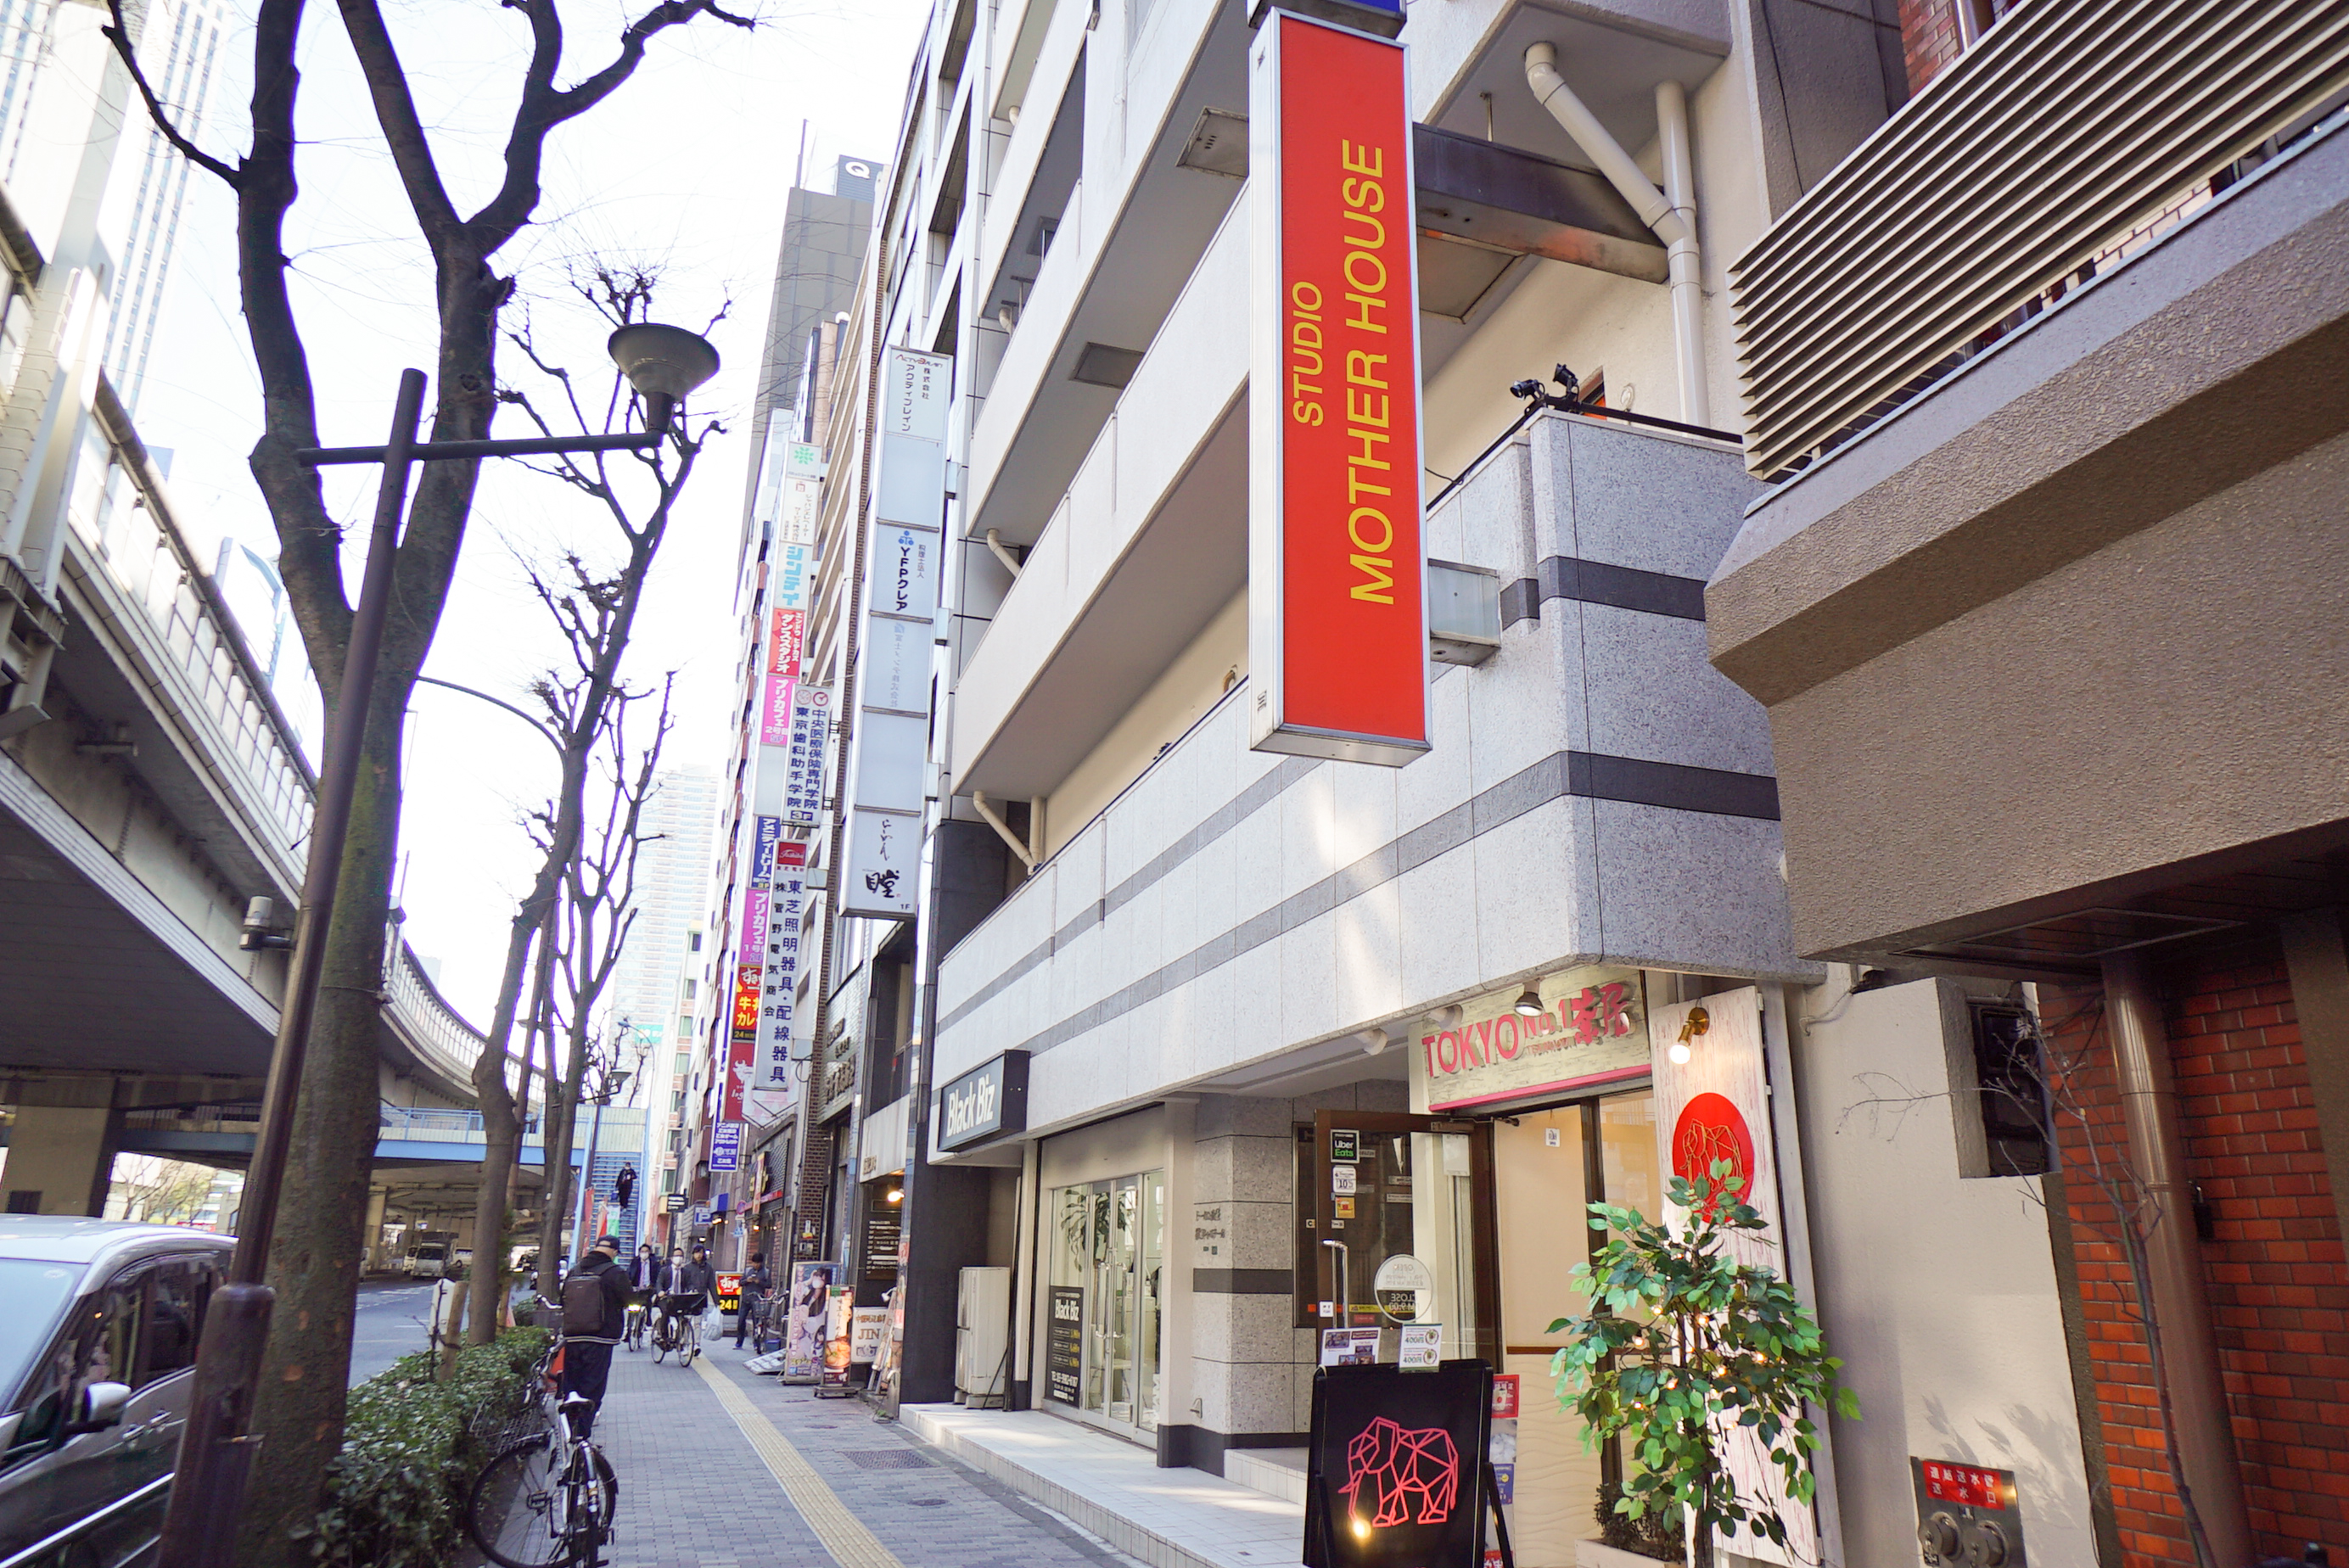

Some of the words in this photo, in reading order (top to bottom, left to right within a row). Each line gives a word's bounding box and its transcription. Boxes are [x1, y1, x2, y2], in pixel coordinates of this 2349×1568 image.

[1342, 138, 1388, 320] HOUSE
[1292, 281, 1324, 427] STUDIO
[901, 364, 915, 431] アクティブレイン
[1345, 350, 1394, 605] MOTHER
[895, 546, 911, 611] YFPクレア
[776, 613, 795, 674] ダンススタジオ
[787, 707, 810, 808] 東京歯科助手学院
[804, 709, 827, 809] 中央医療保険専門学院
[741, 966, 761, 987] すき
[743, 944, 763, 954] 1号
[770, 879, 803, 1083] 東芝照明器具・配線器具
[737, 1011, 759, 1027] カレ
[1421, 1013, 1519, 1078] TOKYO
[946, 1080, 976, 1138] Black
[975, 1072, 996, 1127] Biz
[1334, 1140, 1354, 1149] Uber
[1334, 1148, 1354, 1157] Eats
[698, 1212, 711, 1223] P
[858, 1328, 881, 1340] JIN
[1054, 1298, 1070, 1320] Black
[1069, 1300, 1079, 1322] Biz
[1929, 1466, 1994, 1488] 連結送水管
